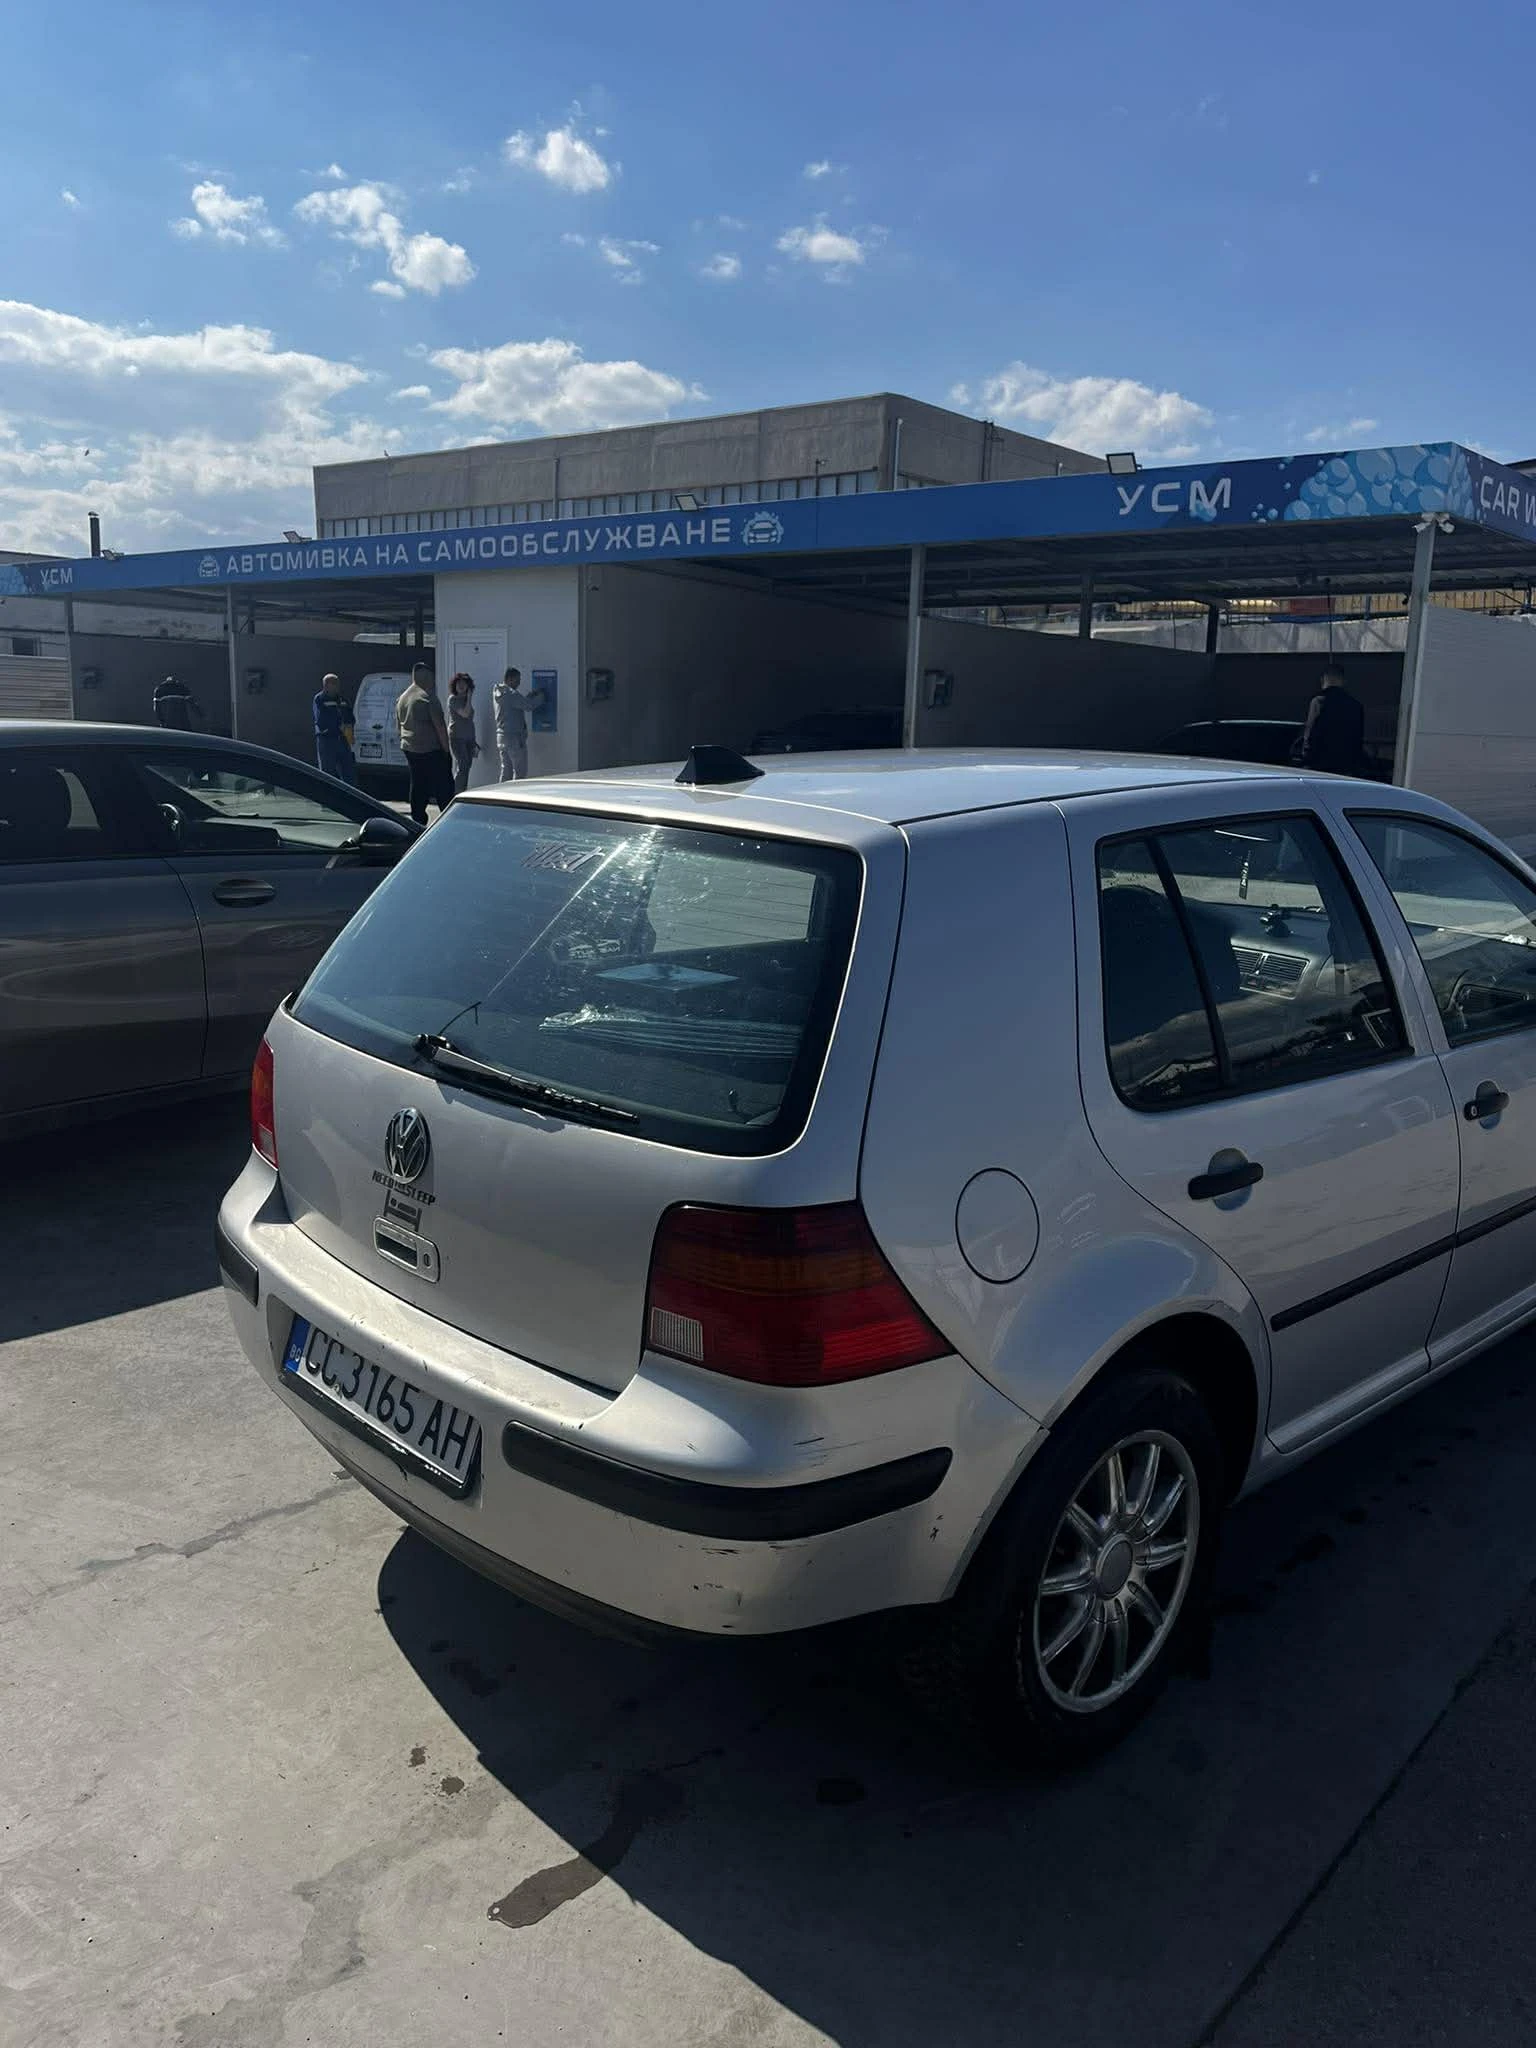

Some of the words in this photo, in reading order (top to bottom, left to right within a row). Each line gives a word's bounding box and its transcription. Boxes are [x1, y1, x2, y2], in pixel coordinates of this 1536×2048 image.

[1480, 475, 1520, 521] CAR
[226, 547, 368, 574] АВТОМИВКА
[375, 544, 409, 565] НА
[417, 517, 732, 563] САМООБСЛУЖВАНЕ
